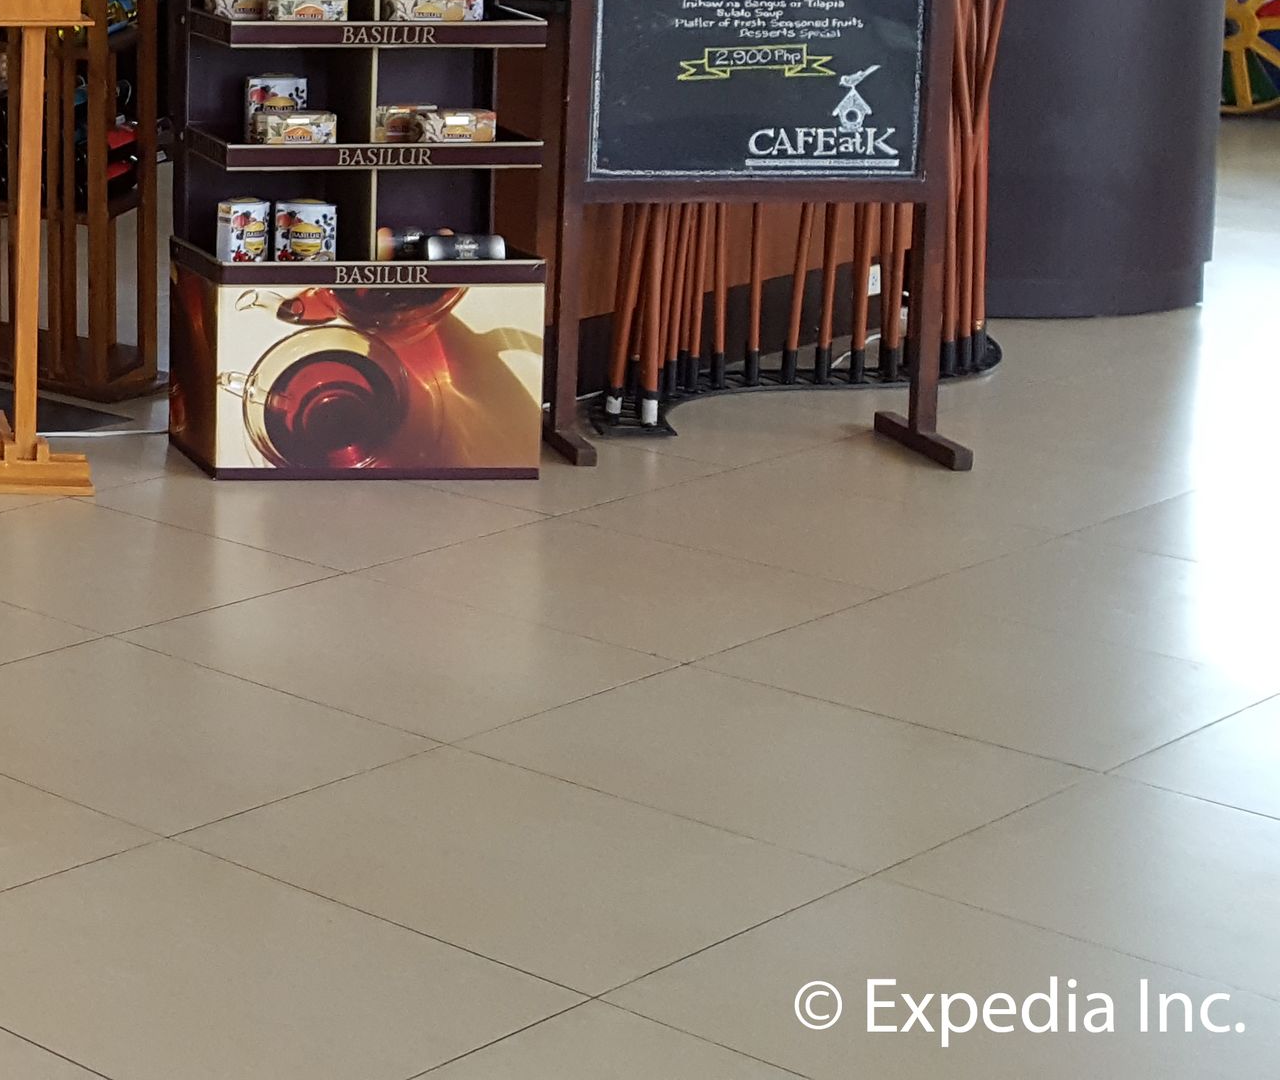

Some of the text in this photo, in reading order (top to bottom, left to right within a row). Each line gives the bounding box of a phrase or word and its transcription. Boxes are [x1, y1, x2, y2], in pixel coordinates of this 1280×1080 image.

[790, 0, 802, 8] or
[754, 9, 784, 19] Soup
[718, 18, 731, 27] of
[770, 18, 829, 28] Seasoned
[342, 26, 437, 44] BASILUR
[739, 29, 796, 38] Desserts
[715, 49, 802, 66] 2,900 Php
[337, 148, 432, 166] BASILUR
[335, 266, 430, 284] BASILUR
